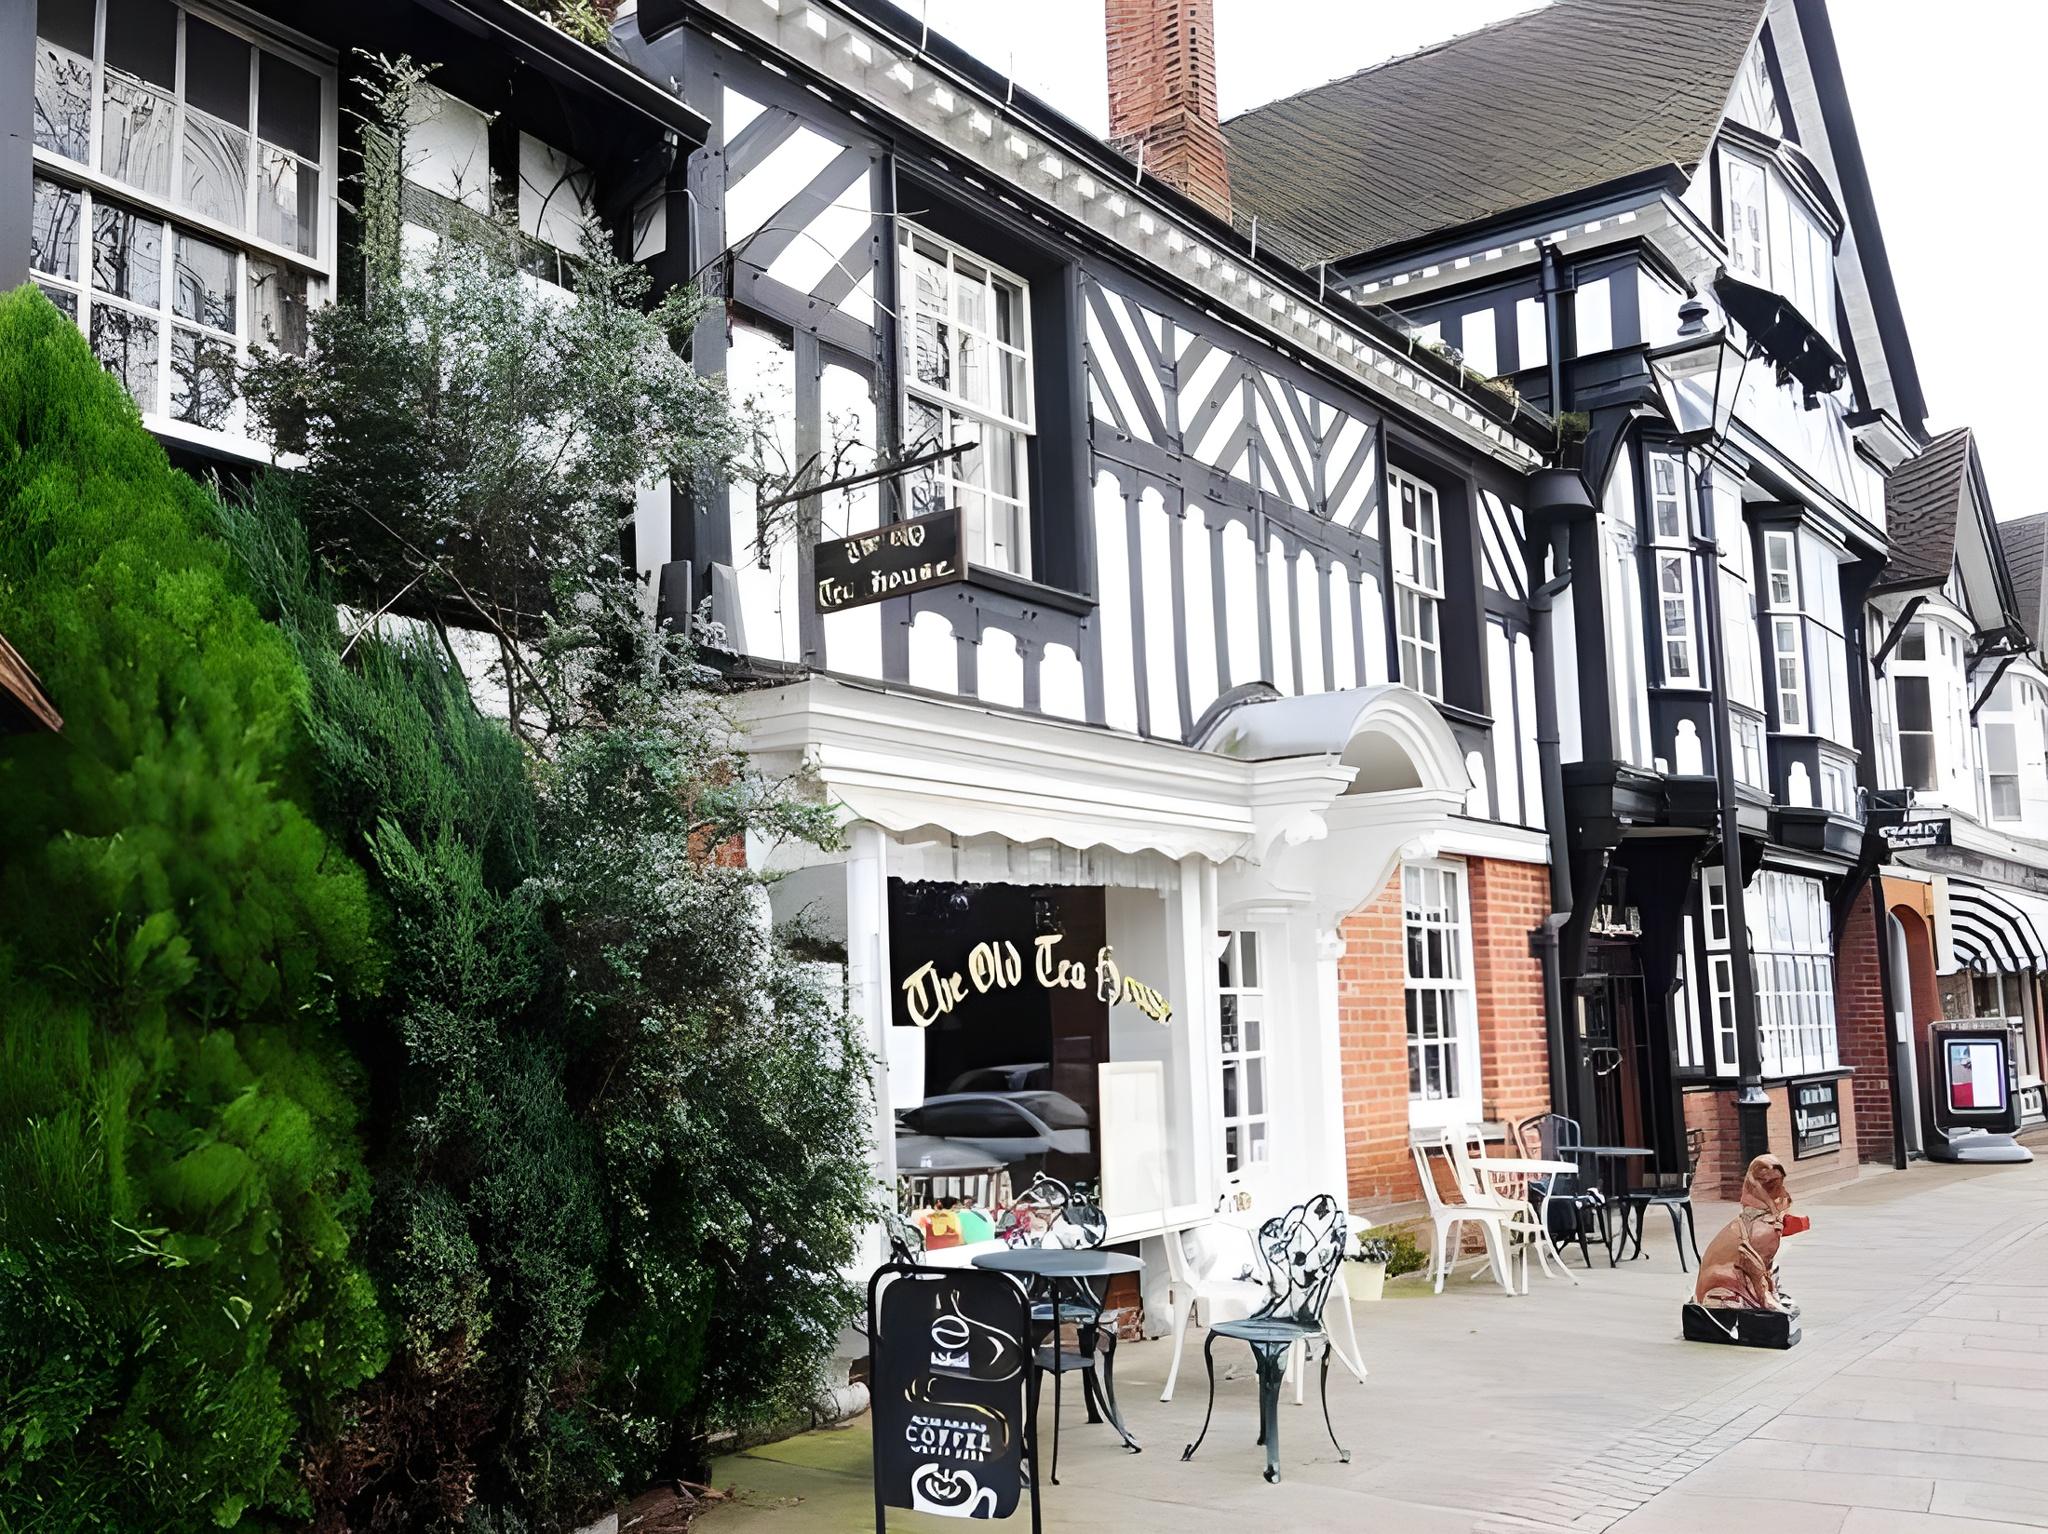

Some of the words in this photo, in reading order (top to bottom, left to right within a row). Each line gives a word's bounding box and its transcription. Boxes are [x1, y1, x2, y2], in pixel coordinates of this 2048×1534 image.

[902, 960, 969, 1028] The
[968, 941, 1022, 994] Old
[1034, 934, 1087, 990] Tea
